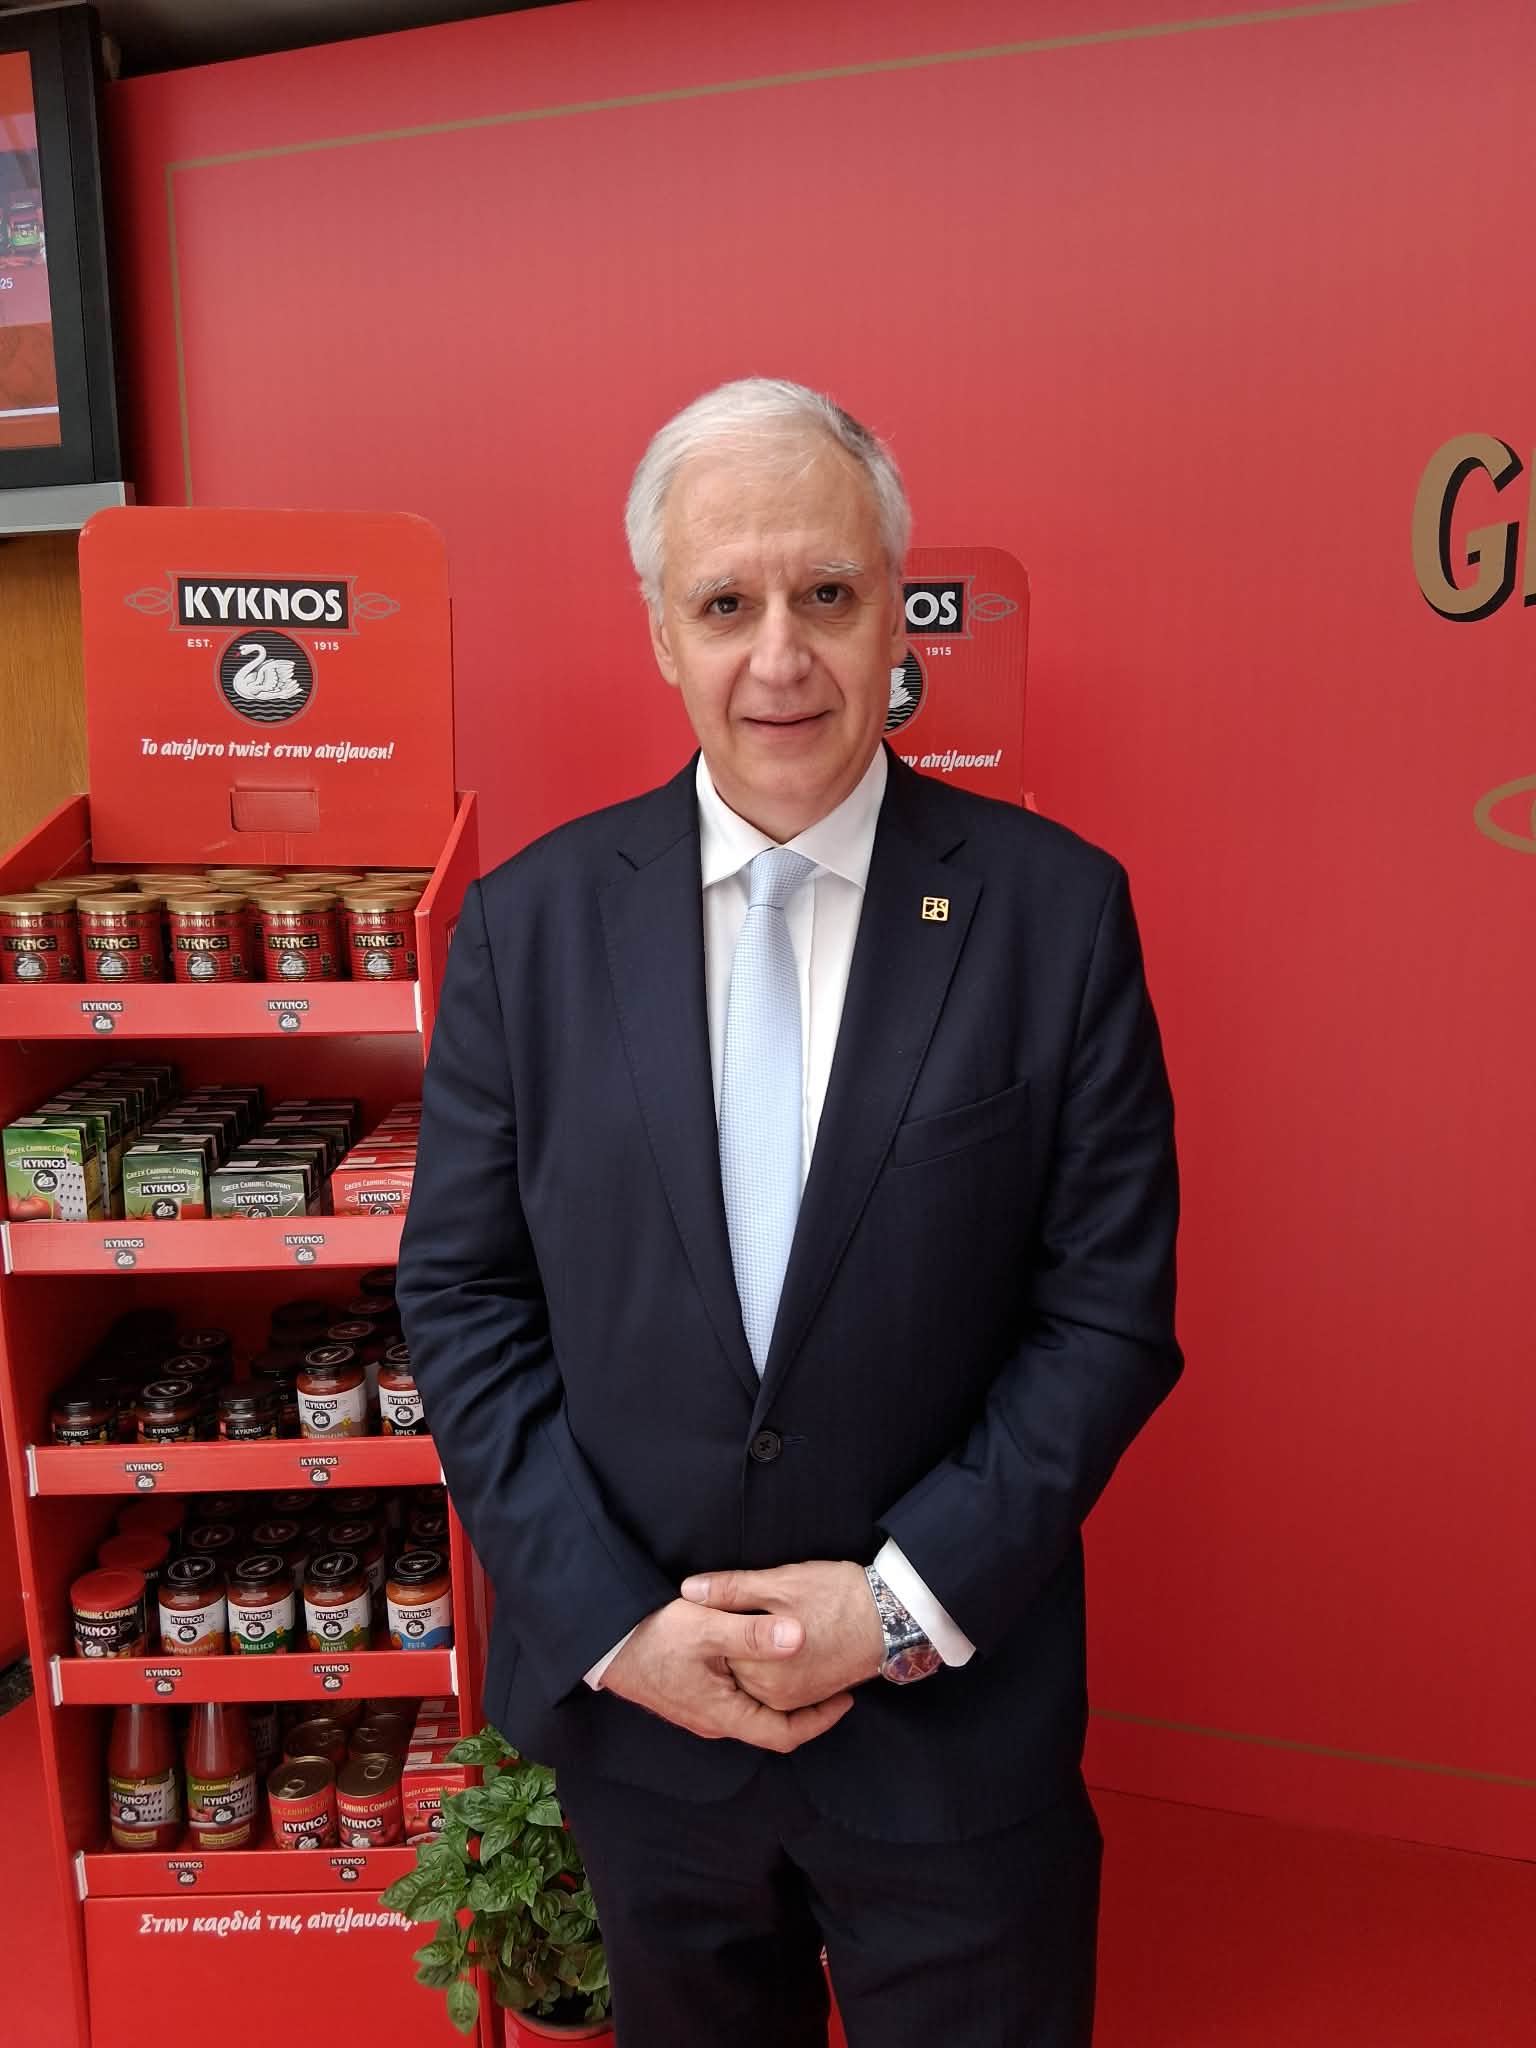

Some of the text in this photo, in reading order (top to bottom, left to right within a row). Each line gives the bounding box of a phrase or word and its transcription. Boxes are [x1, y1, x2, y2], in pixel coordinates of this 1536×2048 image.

[1410, 432, 1536, 623] G
[183, 585, 342, 622] KYKNOS
[186, 638, 340, 651] EST. 1915
[926, 647, 952, 656] 1915
[141, 738, 158, 755] Το
[228, 740, 271, 758] twist
[273, 742, 312, 759] στην
[82, 1002, 123, 1011] KYKNOS
[269, 1000, 309, 1010] KYKNOS
[23, 1159, 66, 1169] KYKNOS
[143, 1183, 186, 1194] KYKNOS
[237, 1194, 279, 1204] KYKNOS
[360, 1192, 401, 1203] KYKNOS
[105, 1239, 144, 1248] KYKNOS
[285, 1235, 324, 1244] KYKNOS
[305, 1400, 337, 1409] KYKNOS
[388, 1396, 420, 1405] KYKNOS
[62, 1429, 89, 1437] KYKNOS
[152, 1426, 179, 1434] KYKNOS
[234, 1426, 262, 1435] KYKNOS
[300, 1457, 338, 1466] KYKNOS
[125, 1462, 164, 1472] KYKNOS
[239, 1611, 272, 1620] KYKNOS
[316, 1609, 349, 1620] KYKNOS
[400, 1608, 431, 1619] KYKNOS
[171, 1614, 204, 1625] KYKNOS
[75, 1622, 117, 1637] KYKNOS
[145, 1668, 182, 1677] KYKNOS
[313, 1664, 350, 1673] KYKNOS
[113, 1792, 148, 1805] KYKNOS
[203, 1791, 242, 1805] KYKNOS
[283, 1812, 329, 1833] KYKNOS
[341, 1814, 383, 1830] KYKNOS
[168, 1861, 204, 1869] KYKNOS
[331, 1857, 366, 1865] KYKNOS
[139, 1913, 188, 1934] Στην
[192, 1911, 261, 1936] καρδιά
[266, 1913, 303, 1935] της
